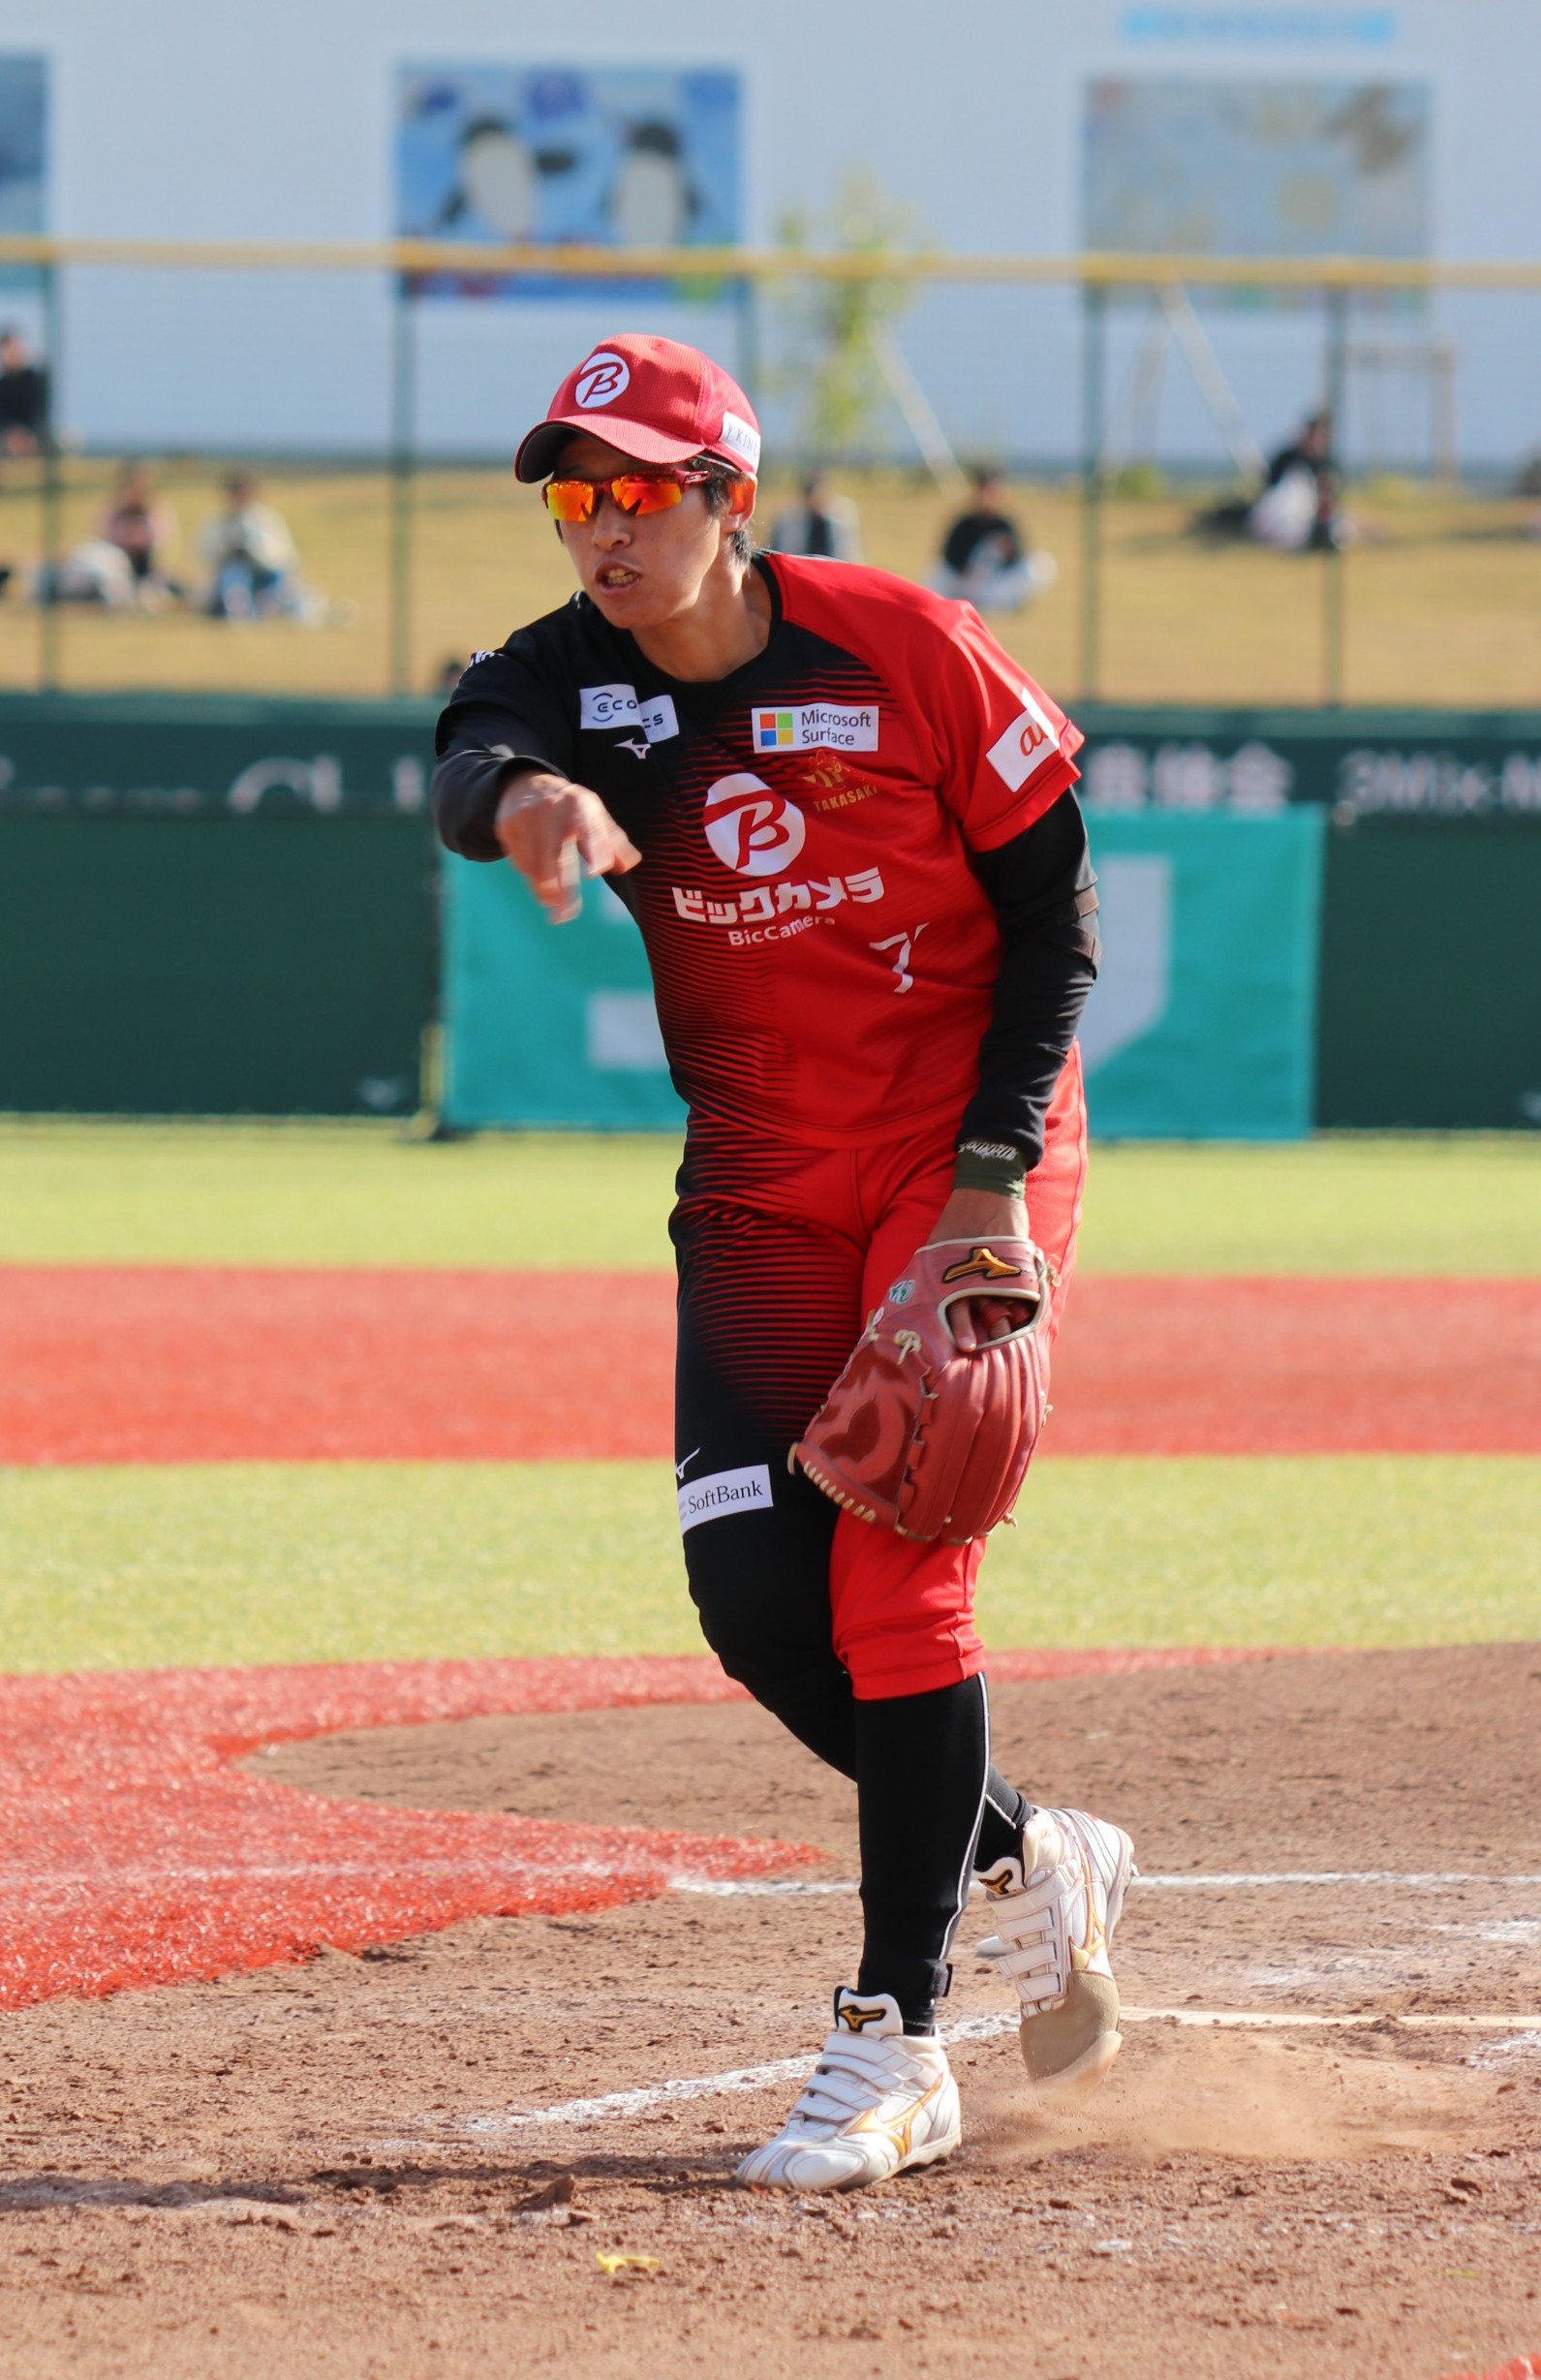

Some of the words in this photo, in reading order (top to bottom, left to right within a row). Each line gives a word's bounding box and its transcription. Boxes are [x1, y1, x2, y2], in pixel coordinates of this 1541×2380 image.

[801, 709, 872, 727] Microsoft
[801, 727, 854, 745] Surface
[814, 785, 878, 813] TAKASAKI
[671, 866, 885, 924] ビックカメラ
[727, 914, 836, 946] BicCamera
[688, 1480, 763, 1514] SoftBank
